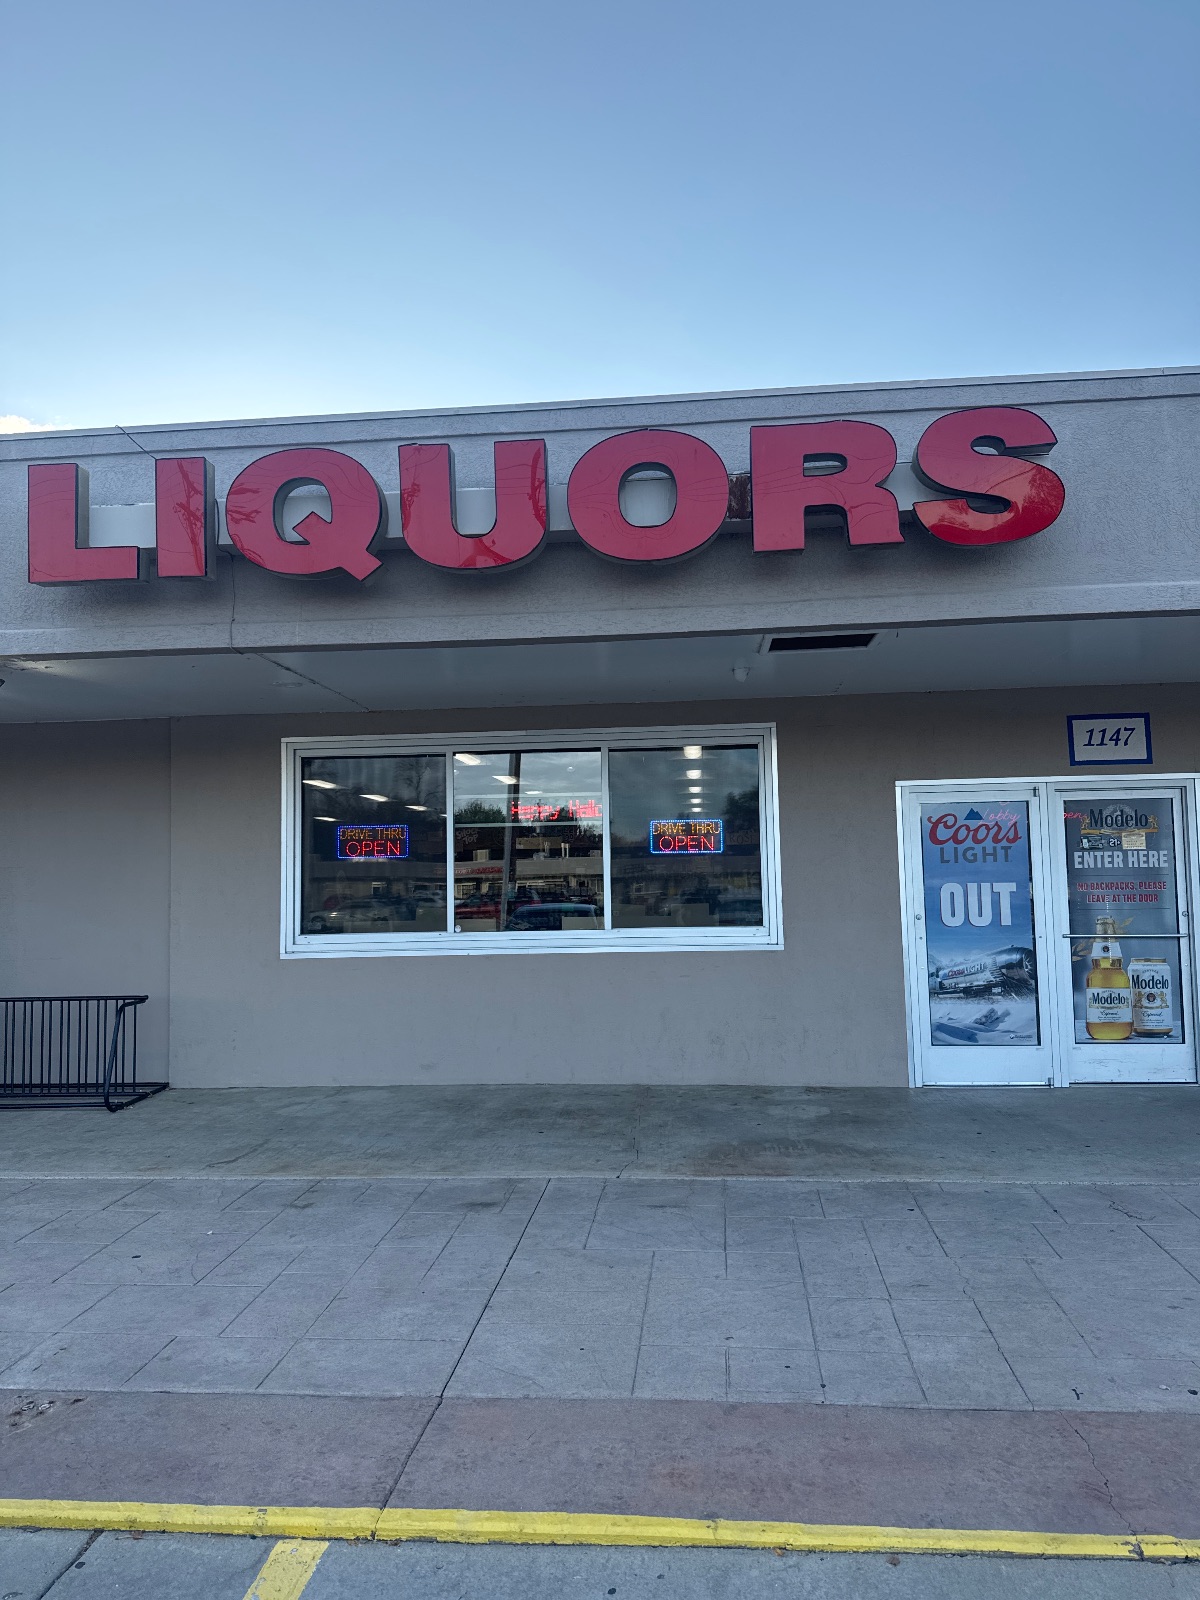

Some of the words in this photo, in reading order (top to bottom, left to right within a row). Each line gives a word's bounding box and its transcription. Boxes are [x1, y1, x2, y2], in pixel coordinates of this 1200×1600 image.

[28, 406, 1065, 586] LIQUORS
[1083, 727, 1136, 747] 1147
[979, 809, 1020, 827] Lobby
[1089, 808, 1149, 828] Modelo
[339, 828, 373, 840] DRIVE
[376, 827, 407, 840] THRU
[652, 822, 686, 834] DRIVE
[689, 821, 720, 834] THRU
[927, 813, 1022, 846] Coors
[346, 841, 400, 857] OPEN
[659, 835, 714, 851] OPEN
[940, 846, 1012, 864] LIGHT
[1074, 851, 1123, 868] ENTER
[1127, 850, 1169, 868] HERE
[1077, 882, 1088, 891] NO
[1139, 881, 1167, 890] PLEASE
[940, 882, 1017, 927] OUT
[1087, 894, 1109, 903] LEAVE
[1112, 894, 1121, 903] AT
[1122, 893, 1137, 903] THE
[1138, 893, 1159, 902] DOOR
[965, 962, 985, 973] LIGHT
[1131, 974, 1169, 990] Modelo
[1092, 992, 1126, 1005] Modelo
